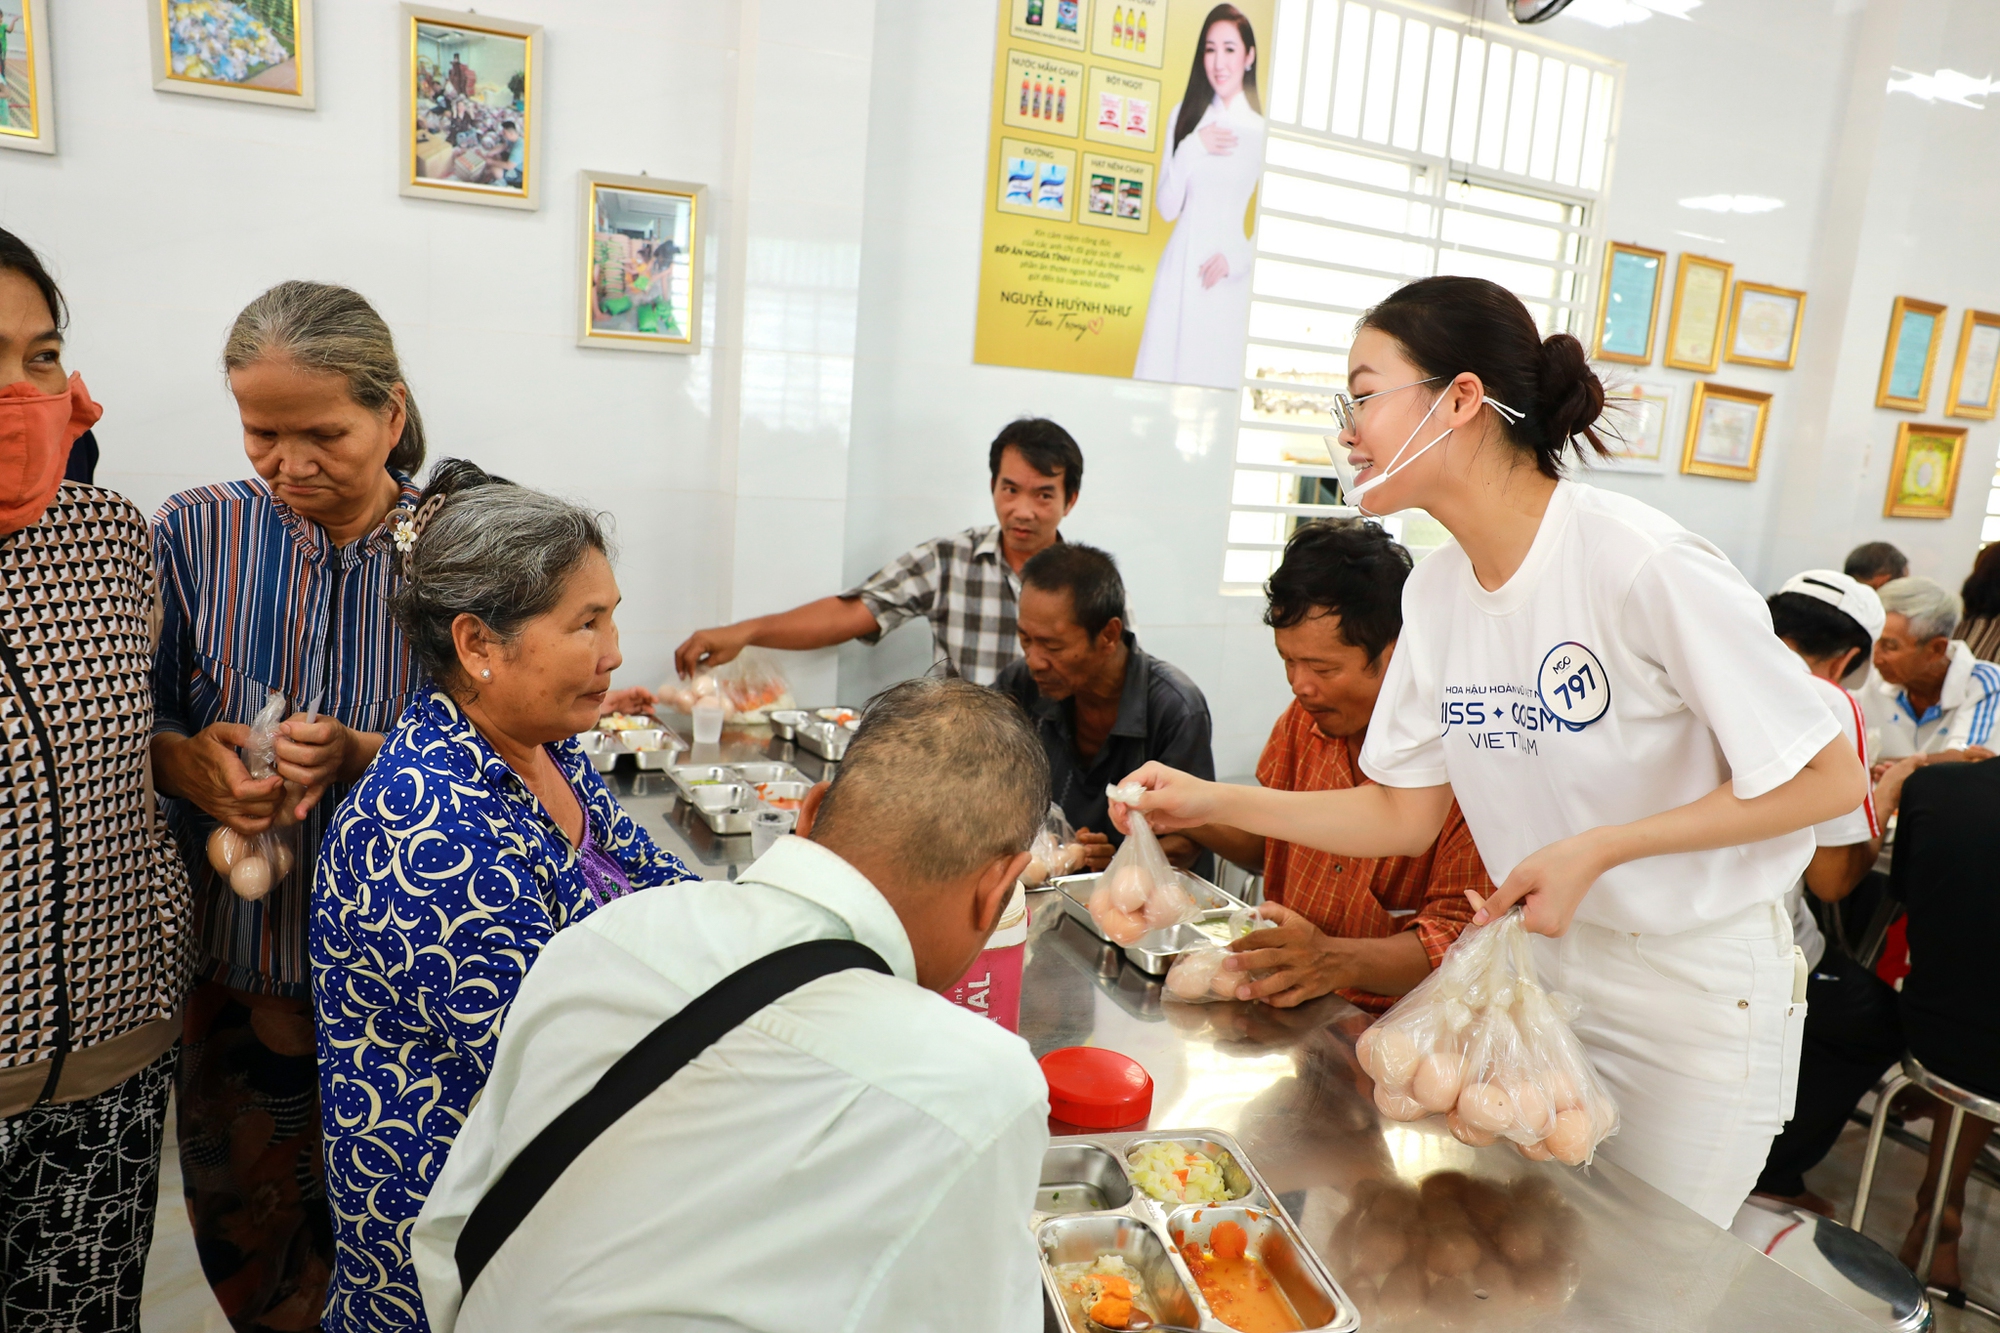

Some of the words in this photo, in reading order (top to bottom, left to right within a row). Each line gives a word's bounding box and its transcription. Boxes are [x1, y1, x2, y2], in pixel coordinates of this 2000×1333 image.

[1000, 290, 1053, 308] NGUYỄN
[1056, 297, 1100, 314] HUỲNH
[1103, 303, 1132, 317] NHƯ
[1446, 686, 1463, 694] HOA
[1466, 684, 1487, 695] HẬU
[1490, 683, 1517, 694] HOÀN
[1553, 663, 1596, 711] 797
[1441, 702, 1486, 725] ISS
[1511, 702, 1587, 733] COSM
[967, 972, 991, 1017] AL
